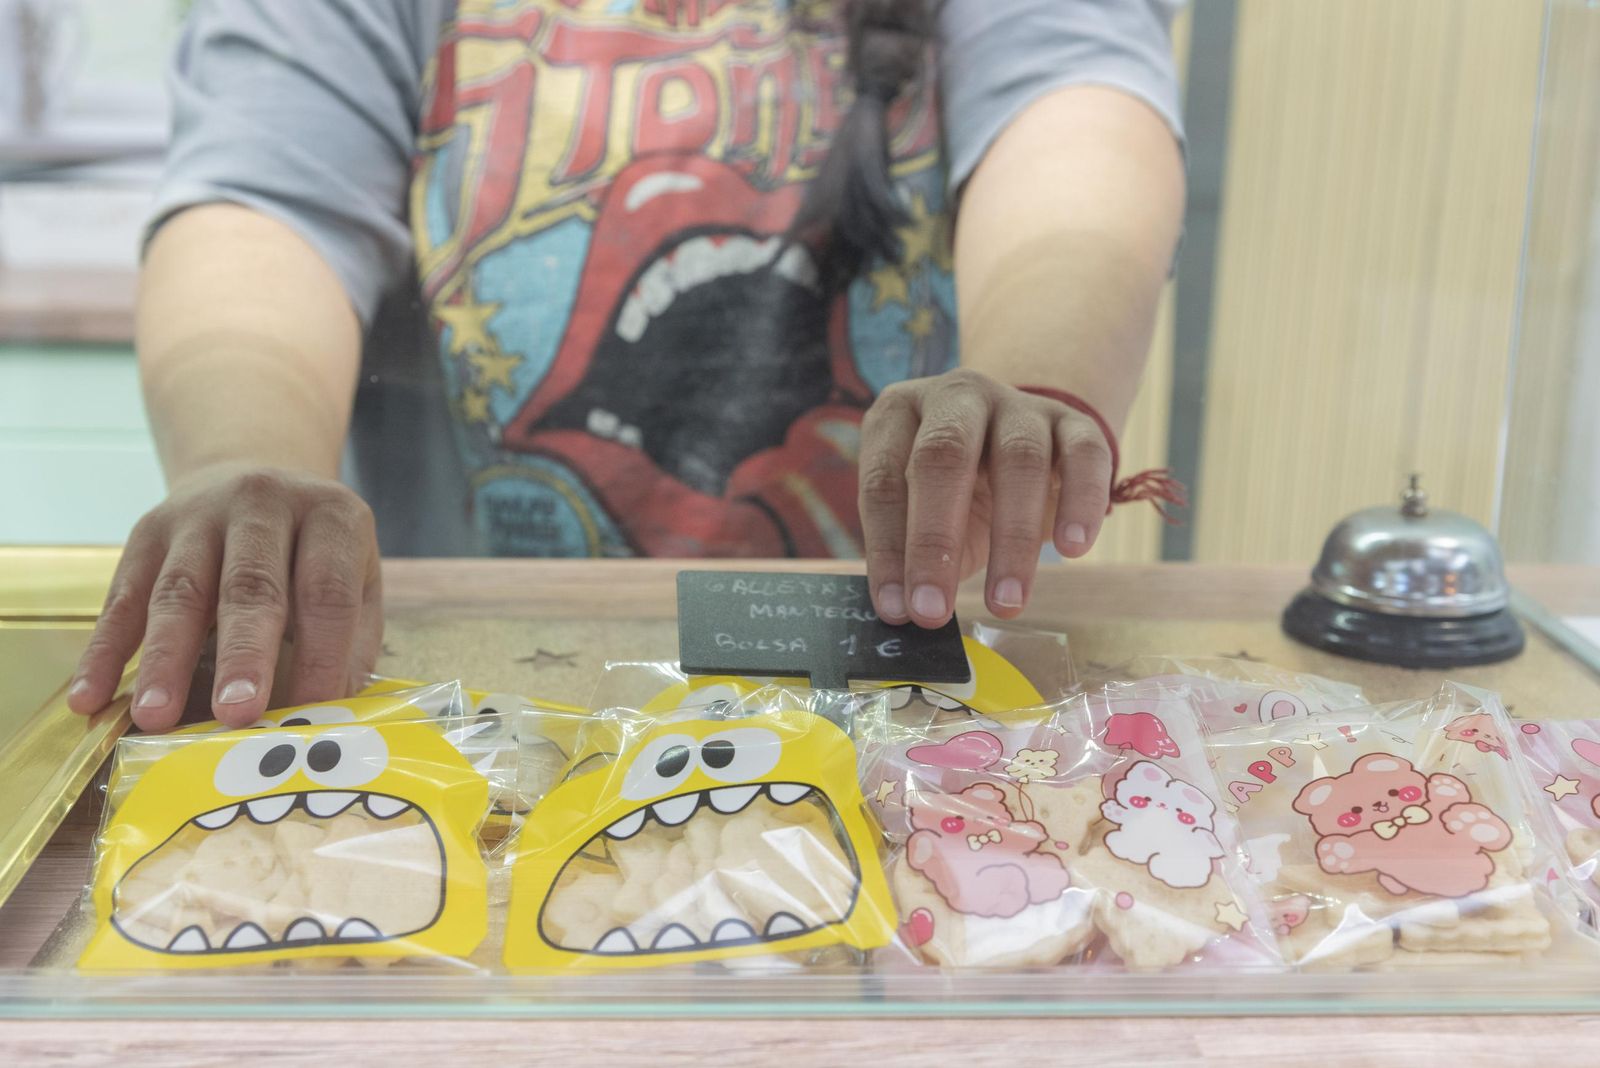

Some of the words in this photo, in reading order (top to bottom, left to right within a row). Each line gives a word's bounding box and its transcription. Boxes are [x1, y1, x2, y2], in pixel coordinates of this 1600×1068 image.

[705, 578, 862, 602] GALLETAS
[750, 603, 878, 622] MANTEQU
[715, 632, 807, 653] BOLSA
[839, 633, 857, 656] 1
[876, 638, 902, 658] €
